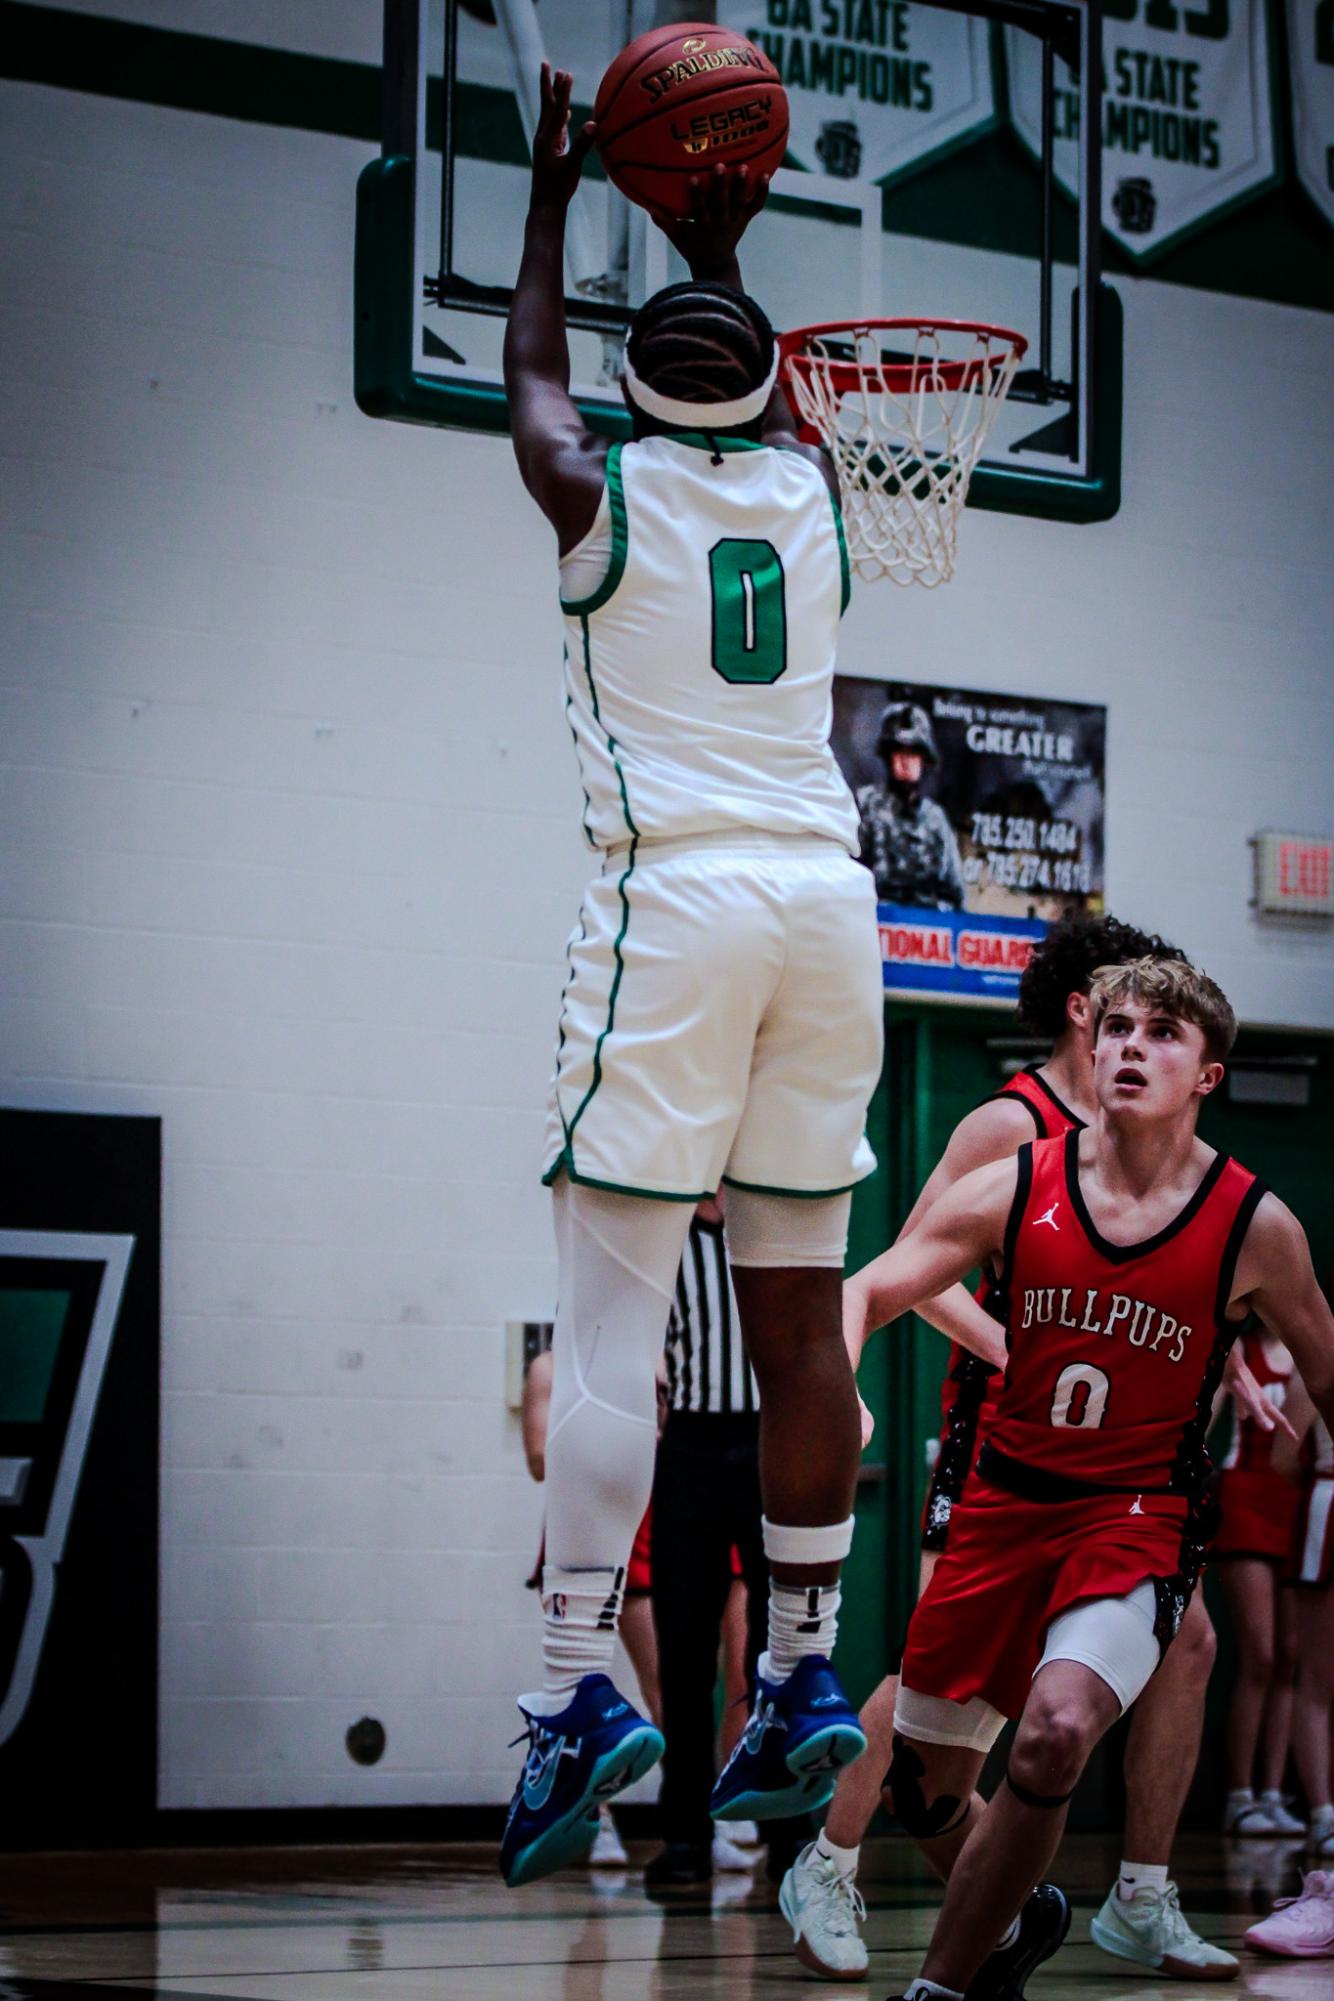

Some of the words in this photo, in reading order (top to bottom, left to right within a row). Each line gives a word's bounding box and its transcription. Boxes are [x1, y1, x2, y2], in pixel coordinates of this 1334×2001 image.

[821, 0, 908, 52] STATE
[639, 47, 769, 103] SPALDING
[747, 29, 932, 112] HAMPIONS
[1115, 47, 1198, 110] STATE
[670, 95, 772, 141] LEGACY
[708, 537, 788, 685] 0
[965, 724, 1074, 763] GREATER
[1021, 1287, 1192, 1363] BULLPUPS
[1050, 1362, 1111, 1430] 0
